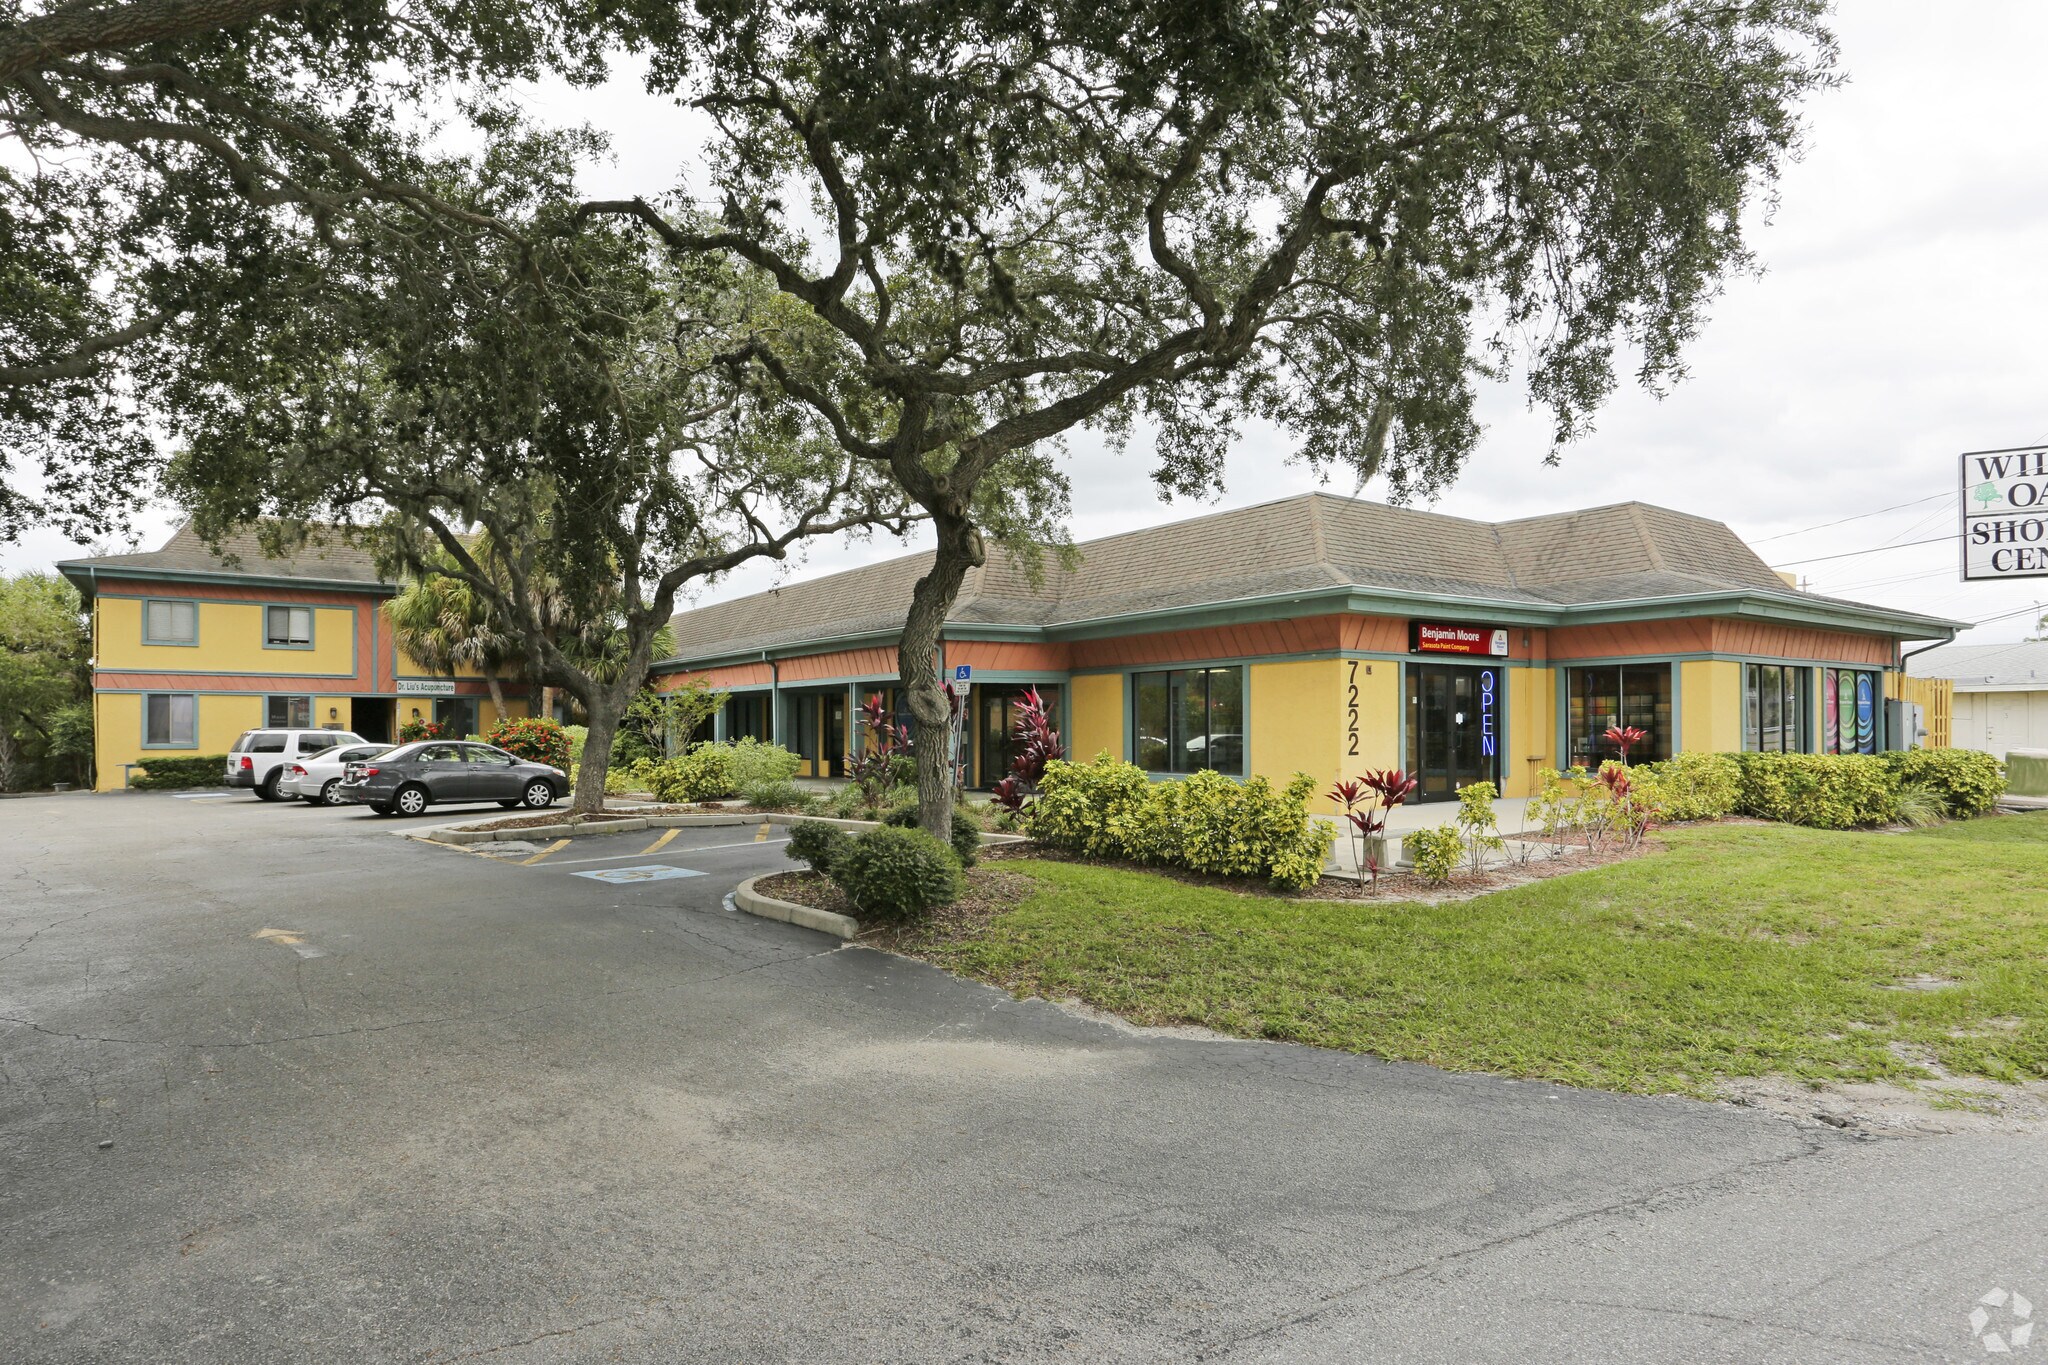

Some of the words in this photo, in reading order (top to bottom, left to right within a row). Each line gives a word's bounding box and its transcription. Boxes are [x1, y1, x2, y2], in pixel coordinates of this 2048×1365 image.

[1975, 453, 2048, 480] WIL
[1972, 518, 2048, 545] SHO
[1422, 627, 1456, 641] Benjamin
[1457, 630, 1480, 641] Moore
[1451, 644, 1470, 652] Company
[1347, 661, 1359, 755] 7222
[1481, 670, 1494, 756] OPEN
